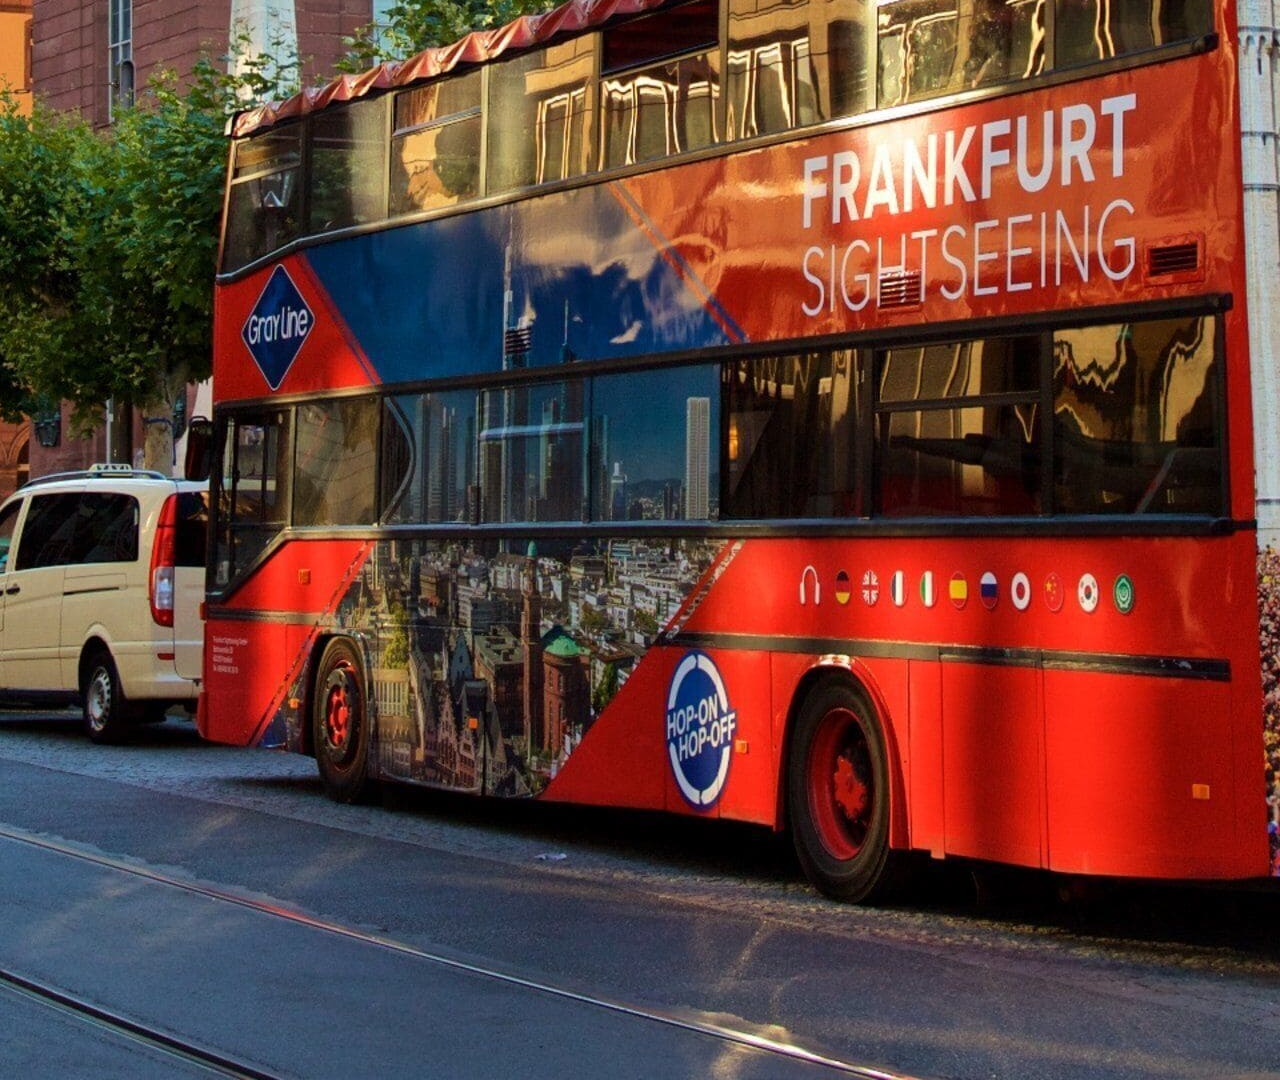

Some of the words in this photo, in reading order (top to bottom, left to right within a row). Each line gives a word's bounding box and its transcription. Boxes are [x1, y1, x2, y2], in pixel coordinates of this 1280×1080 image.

[802, 92, 1137, 229] FRANKFURT
[801, 198, 1136, 318] SIGHTSEEING
[667, 693, 718, 740] HOP-ON
[678, 712, 736, 762] HOP-OFF
